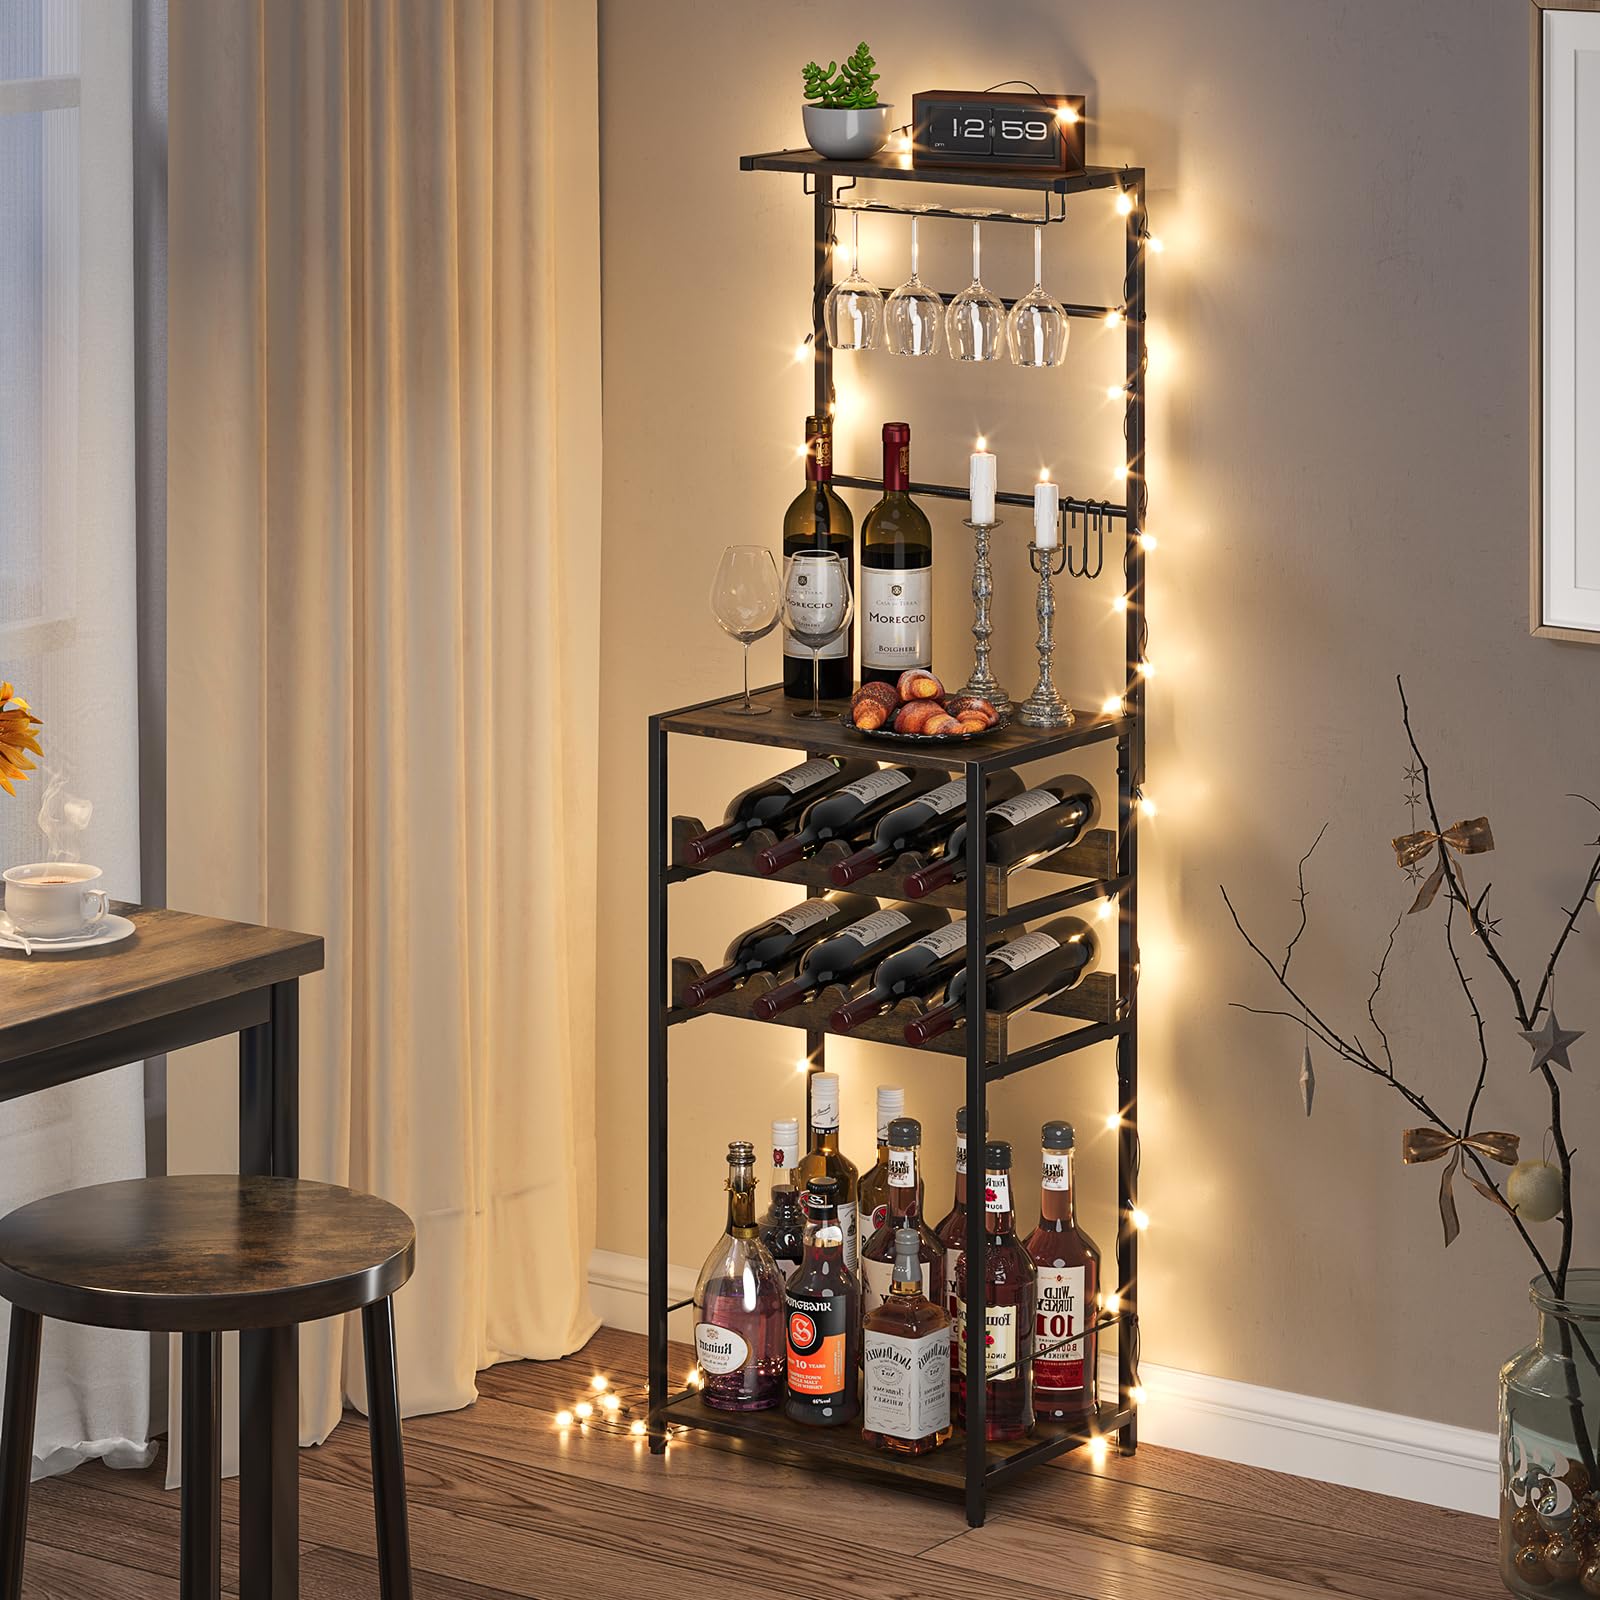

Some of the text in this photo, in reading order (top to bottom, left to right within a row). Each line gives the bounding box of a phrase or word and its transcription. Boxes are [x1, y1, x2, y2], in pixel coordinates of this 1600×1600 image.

[952, 118, 1048, 141] 12 59
[869, 612, 926, 624] MORECCIO
[796, 1360, 807, 1370] 10
